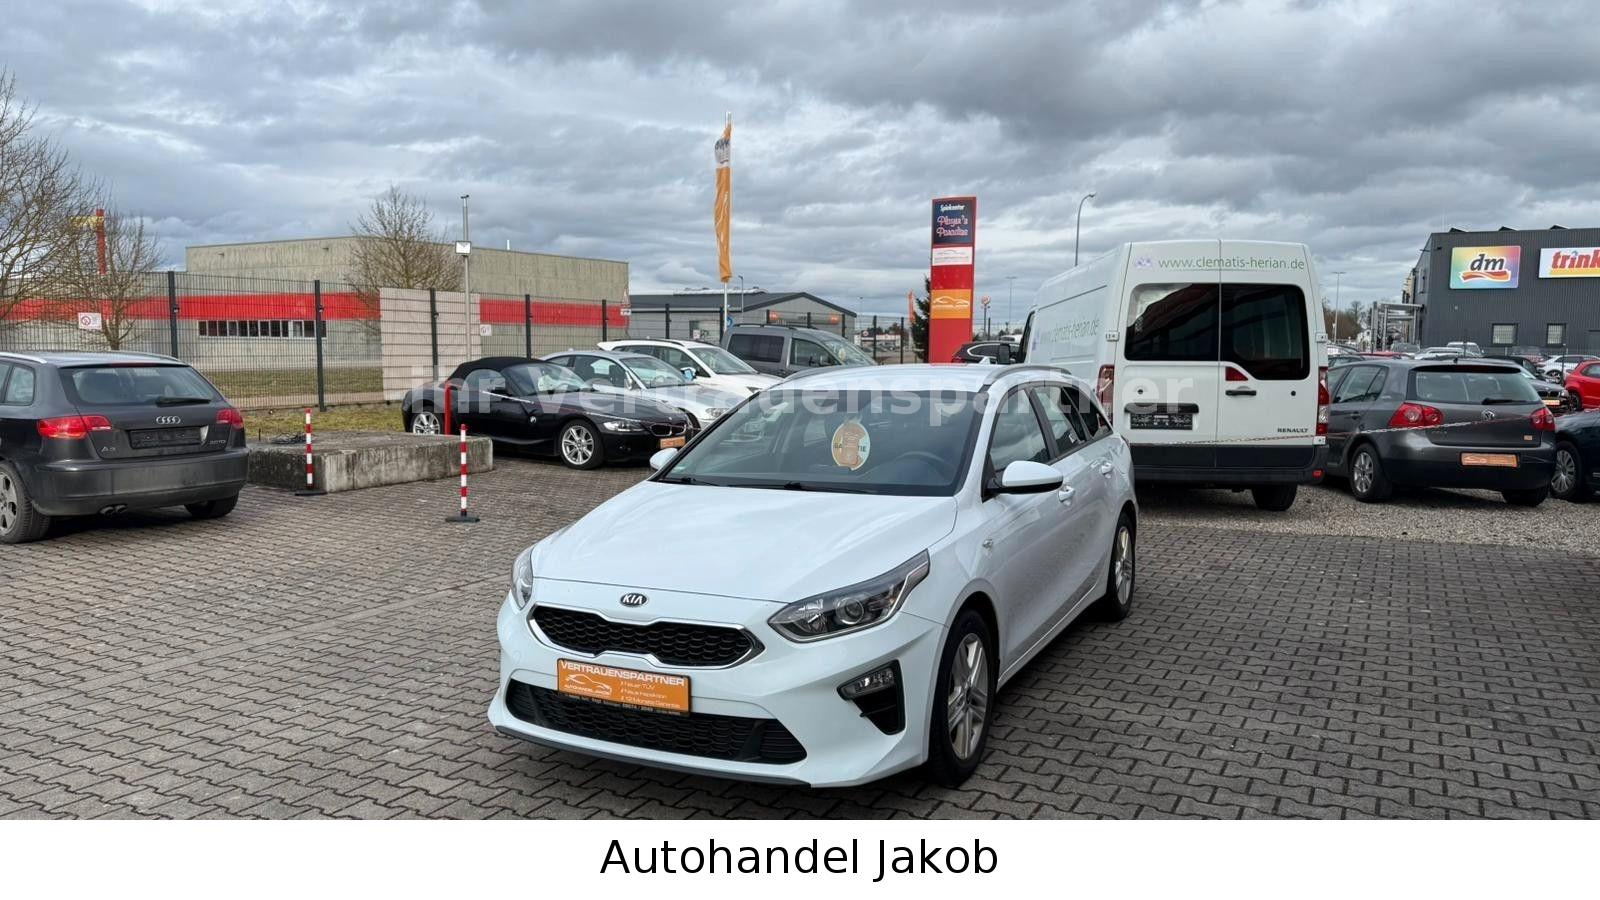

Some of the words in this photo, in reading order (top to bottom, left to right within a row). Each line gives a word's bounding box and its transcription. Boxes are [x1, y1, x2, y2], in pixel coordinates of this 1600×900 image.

[1158, 256, 1305, 270] www.clematis-herian.de
[1470, 253, 1505, 271] dm
[622, 595, 643, 604] KIA
[560, 661, 685, 686] VERTRAUENSPARTNER
